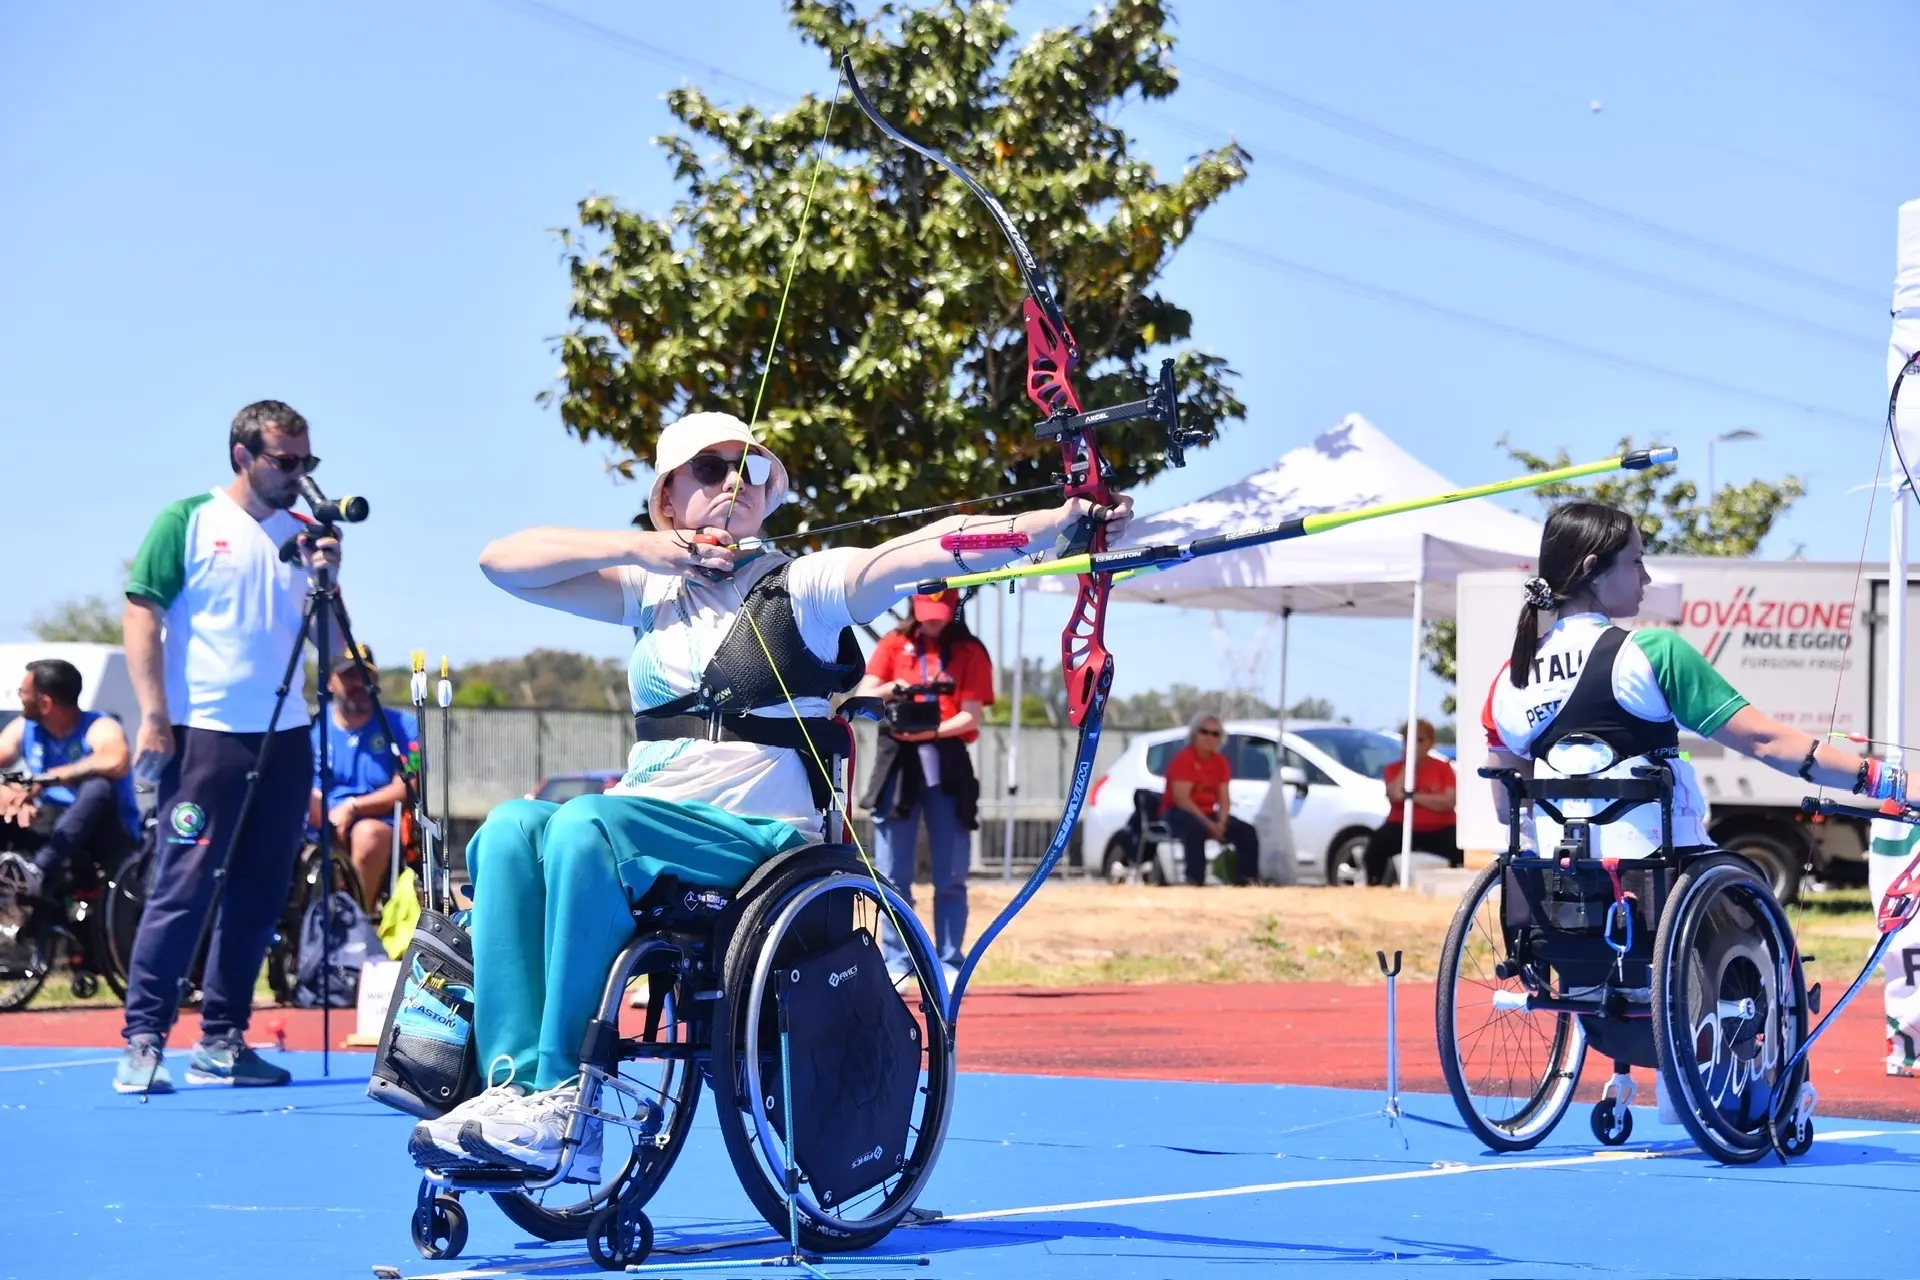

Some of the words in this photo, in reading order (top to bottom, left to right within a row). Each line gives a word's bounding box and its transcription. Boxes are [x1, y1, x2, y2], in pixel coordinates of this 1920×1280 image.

[1085, 413, 1109, 423] AXCEL
[1106, 551, 1142, 561] EASTON
[1633, 602, 1855, 629] OVAZIONE
[1742, 632, 1852, 649] NOLEGGIO
[1530, 650, 1582, 684] TALI
[1054, 761, 1089, 848] WIAWIS
[412, 1001, 456, 1028] EASTON
